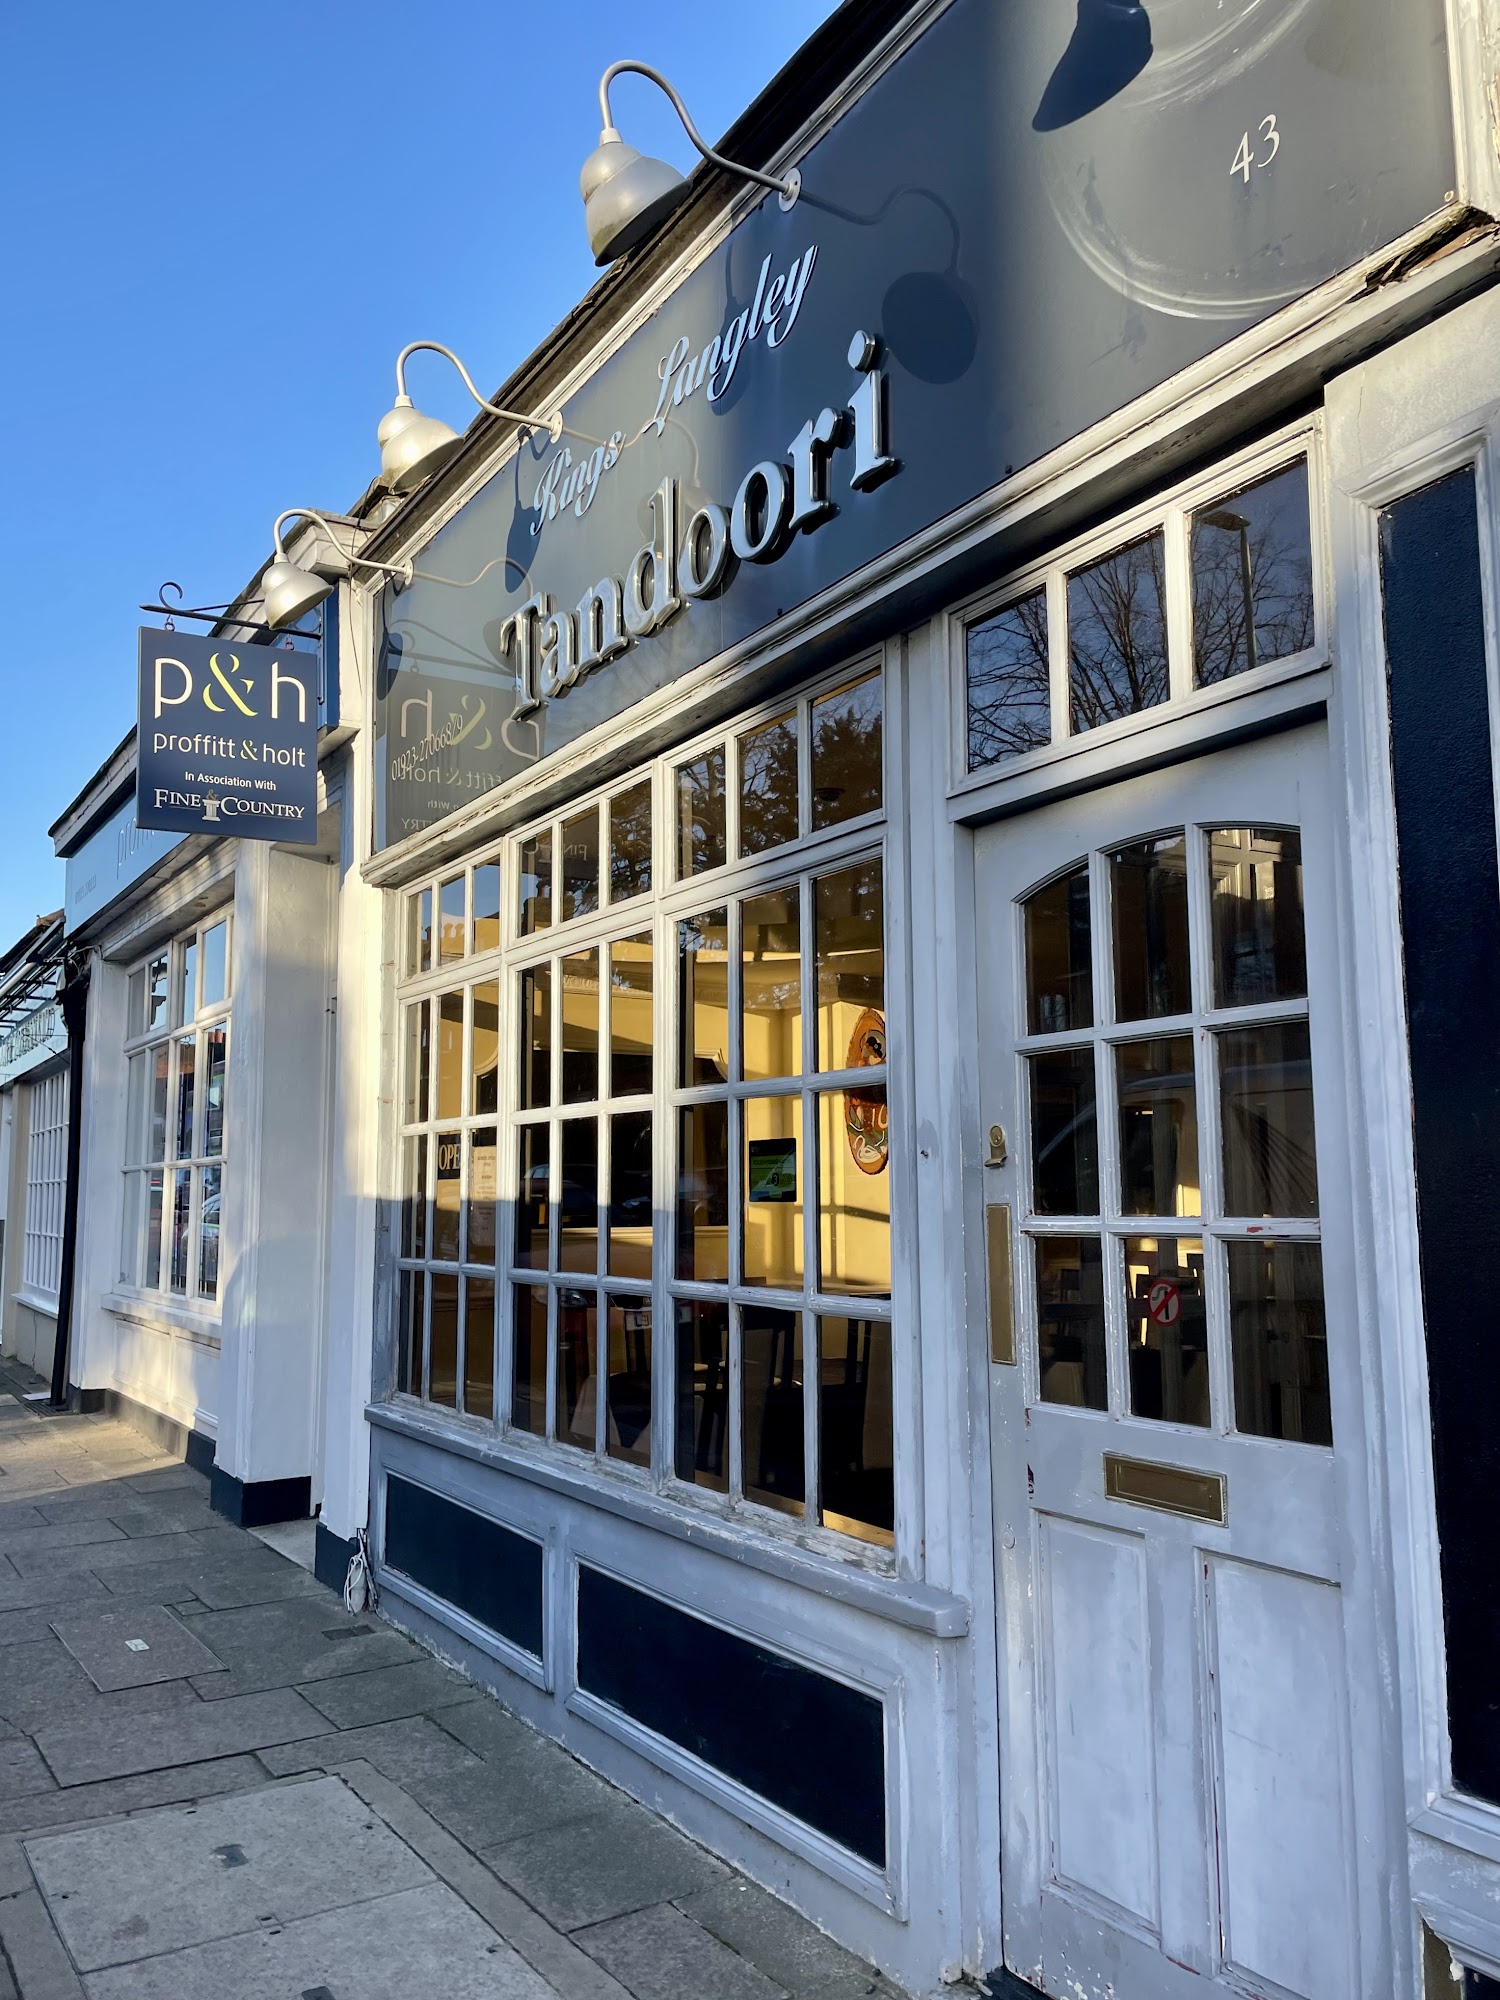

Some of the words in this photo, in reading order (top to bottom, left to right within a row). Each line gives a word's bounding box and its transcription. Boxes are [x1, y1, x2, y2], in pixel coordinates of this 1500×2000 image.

[1229, 113, 1280, 184] 43
[529, 430, 627, 537] Kings
[642, 245, 820, 437] Langley
[500, 329, 898, 722] Tandoori
[153, 732, 236, 759] proffitt
[263, 743, 306, 768] holt
[185, 771, 195, 782] In
[197, 772, 251, 788] Association
[254, 779, 277, 791] With
[153, 788, 201, 809] FINE
[220, 796, 305, 818] COUNTRY
[438, 1143, 460, 1170] OPE
